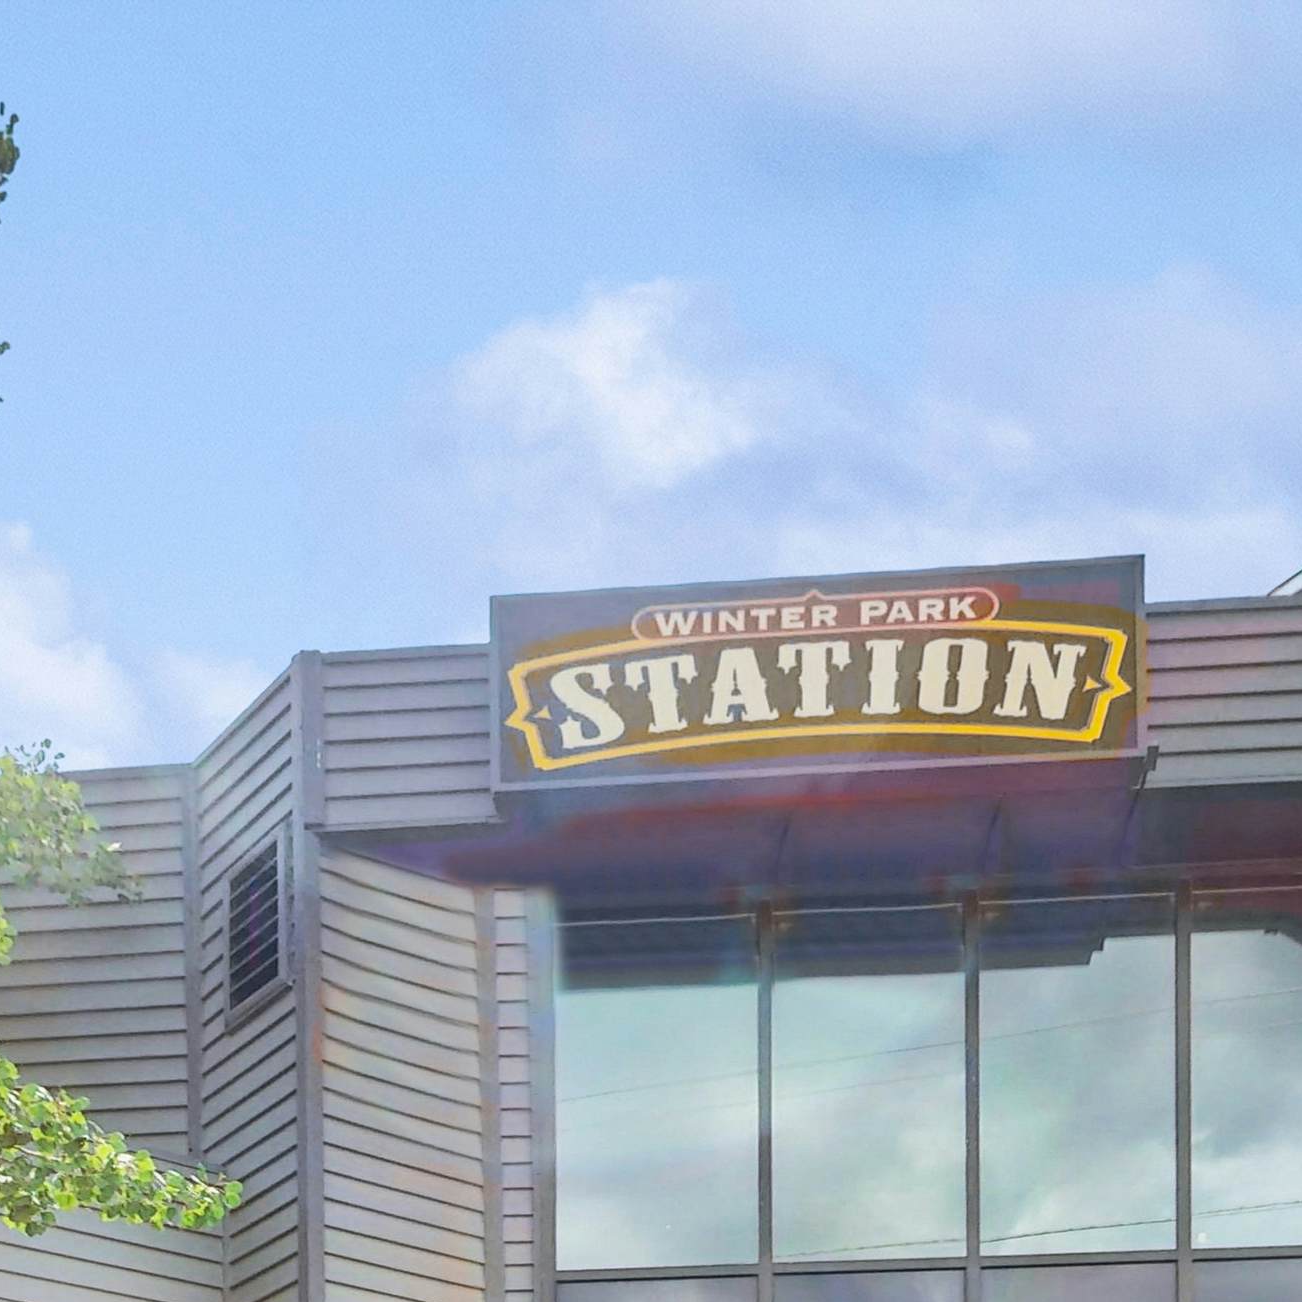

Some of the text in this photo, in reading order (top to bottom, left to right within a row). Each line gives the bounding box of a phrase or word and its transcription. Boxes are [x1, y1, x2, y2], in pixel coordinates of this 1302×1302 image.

[655, 596, 979, 636] WINTER PARK
[550, 637, 1087, 750] STATION
